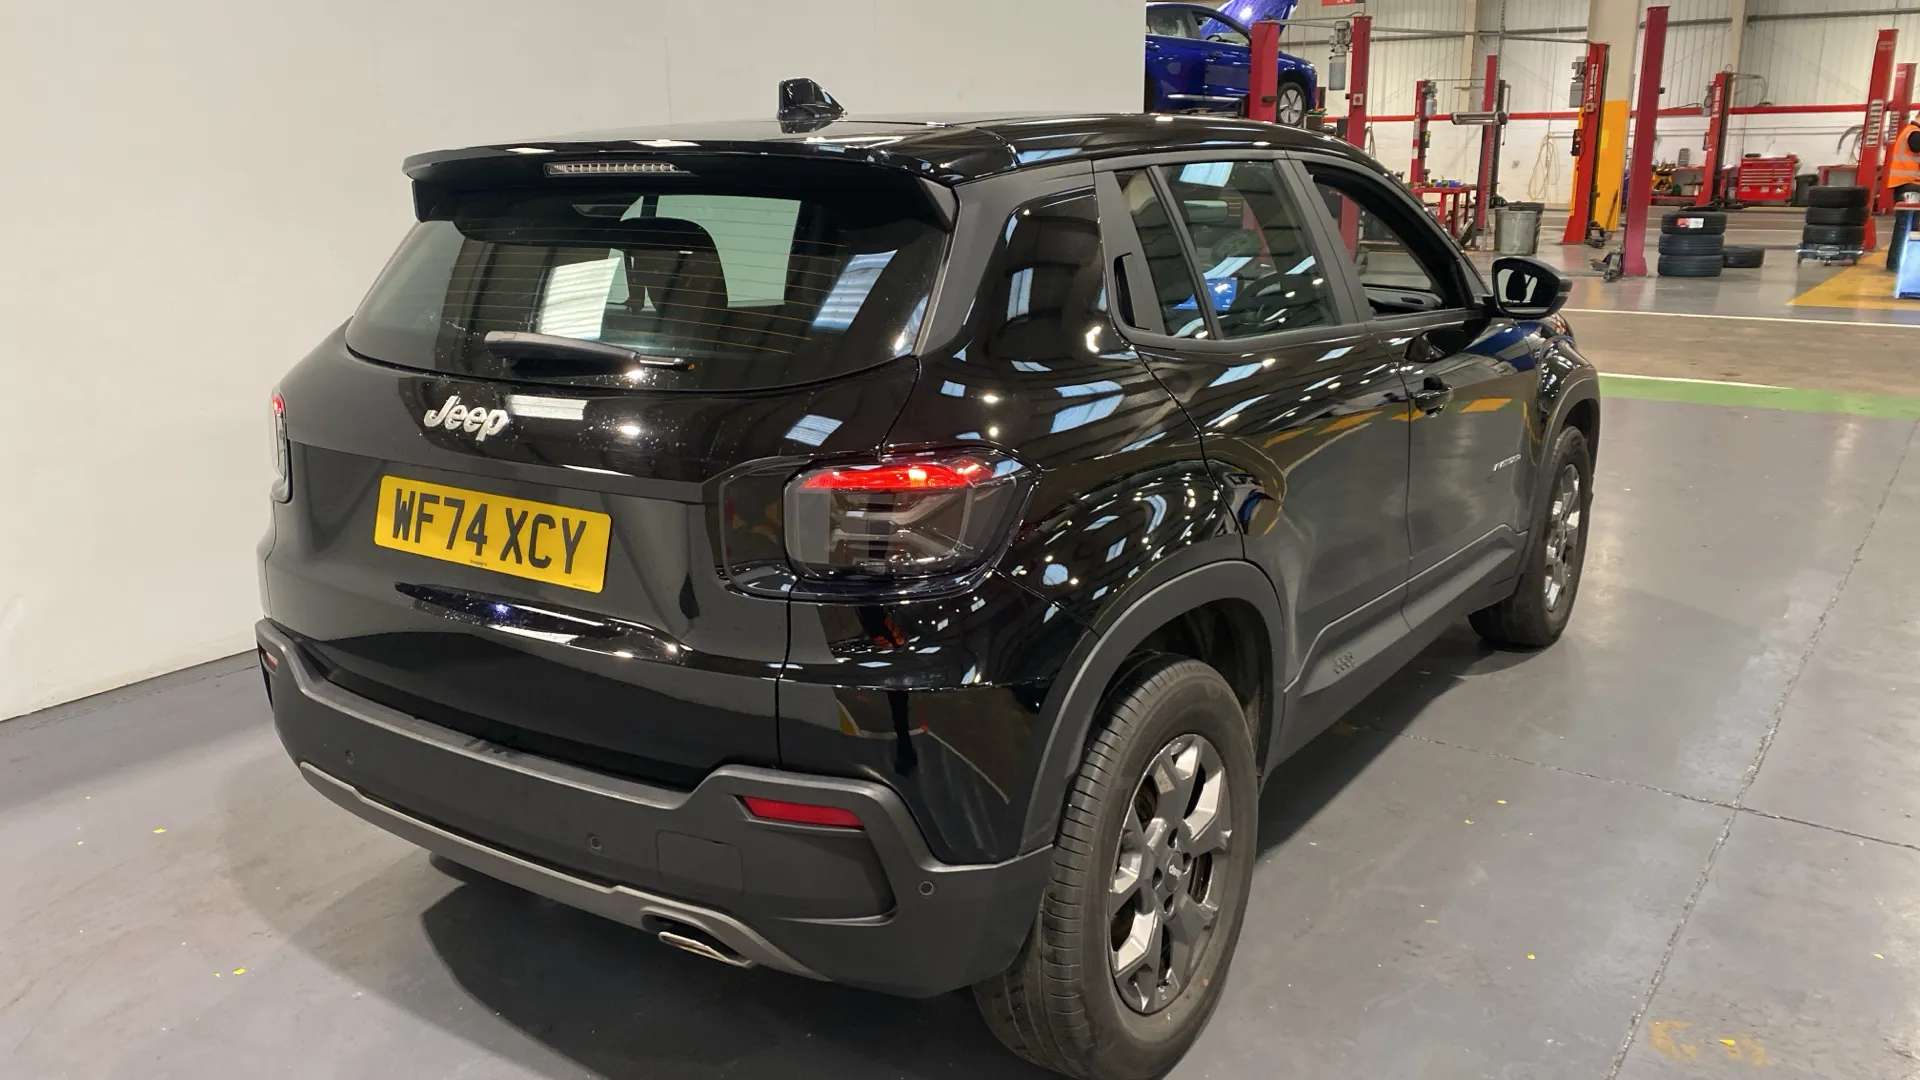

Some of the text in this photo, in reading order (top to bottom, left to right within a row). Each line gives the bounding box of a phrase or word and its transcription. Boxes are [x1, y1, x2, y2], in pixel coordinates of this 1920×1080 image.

[424, 395, 509, 441] Jeep
[392, 488, 587, 574] WF74 XCY
